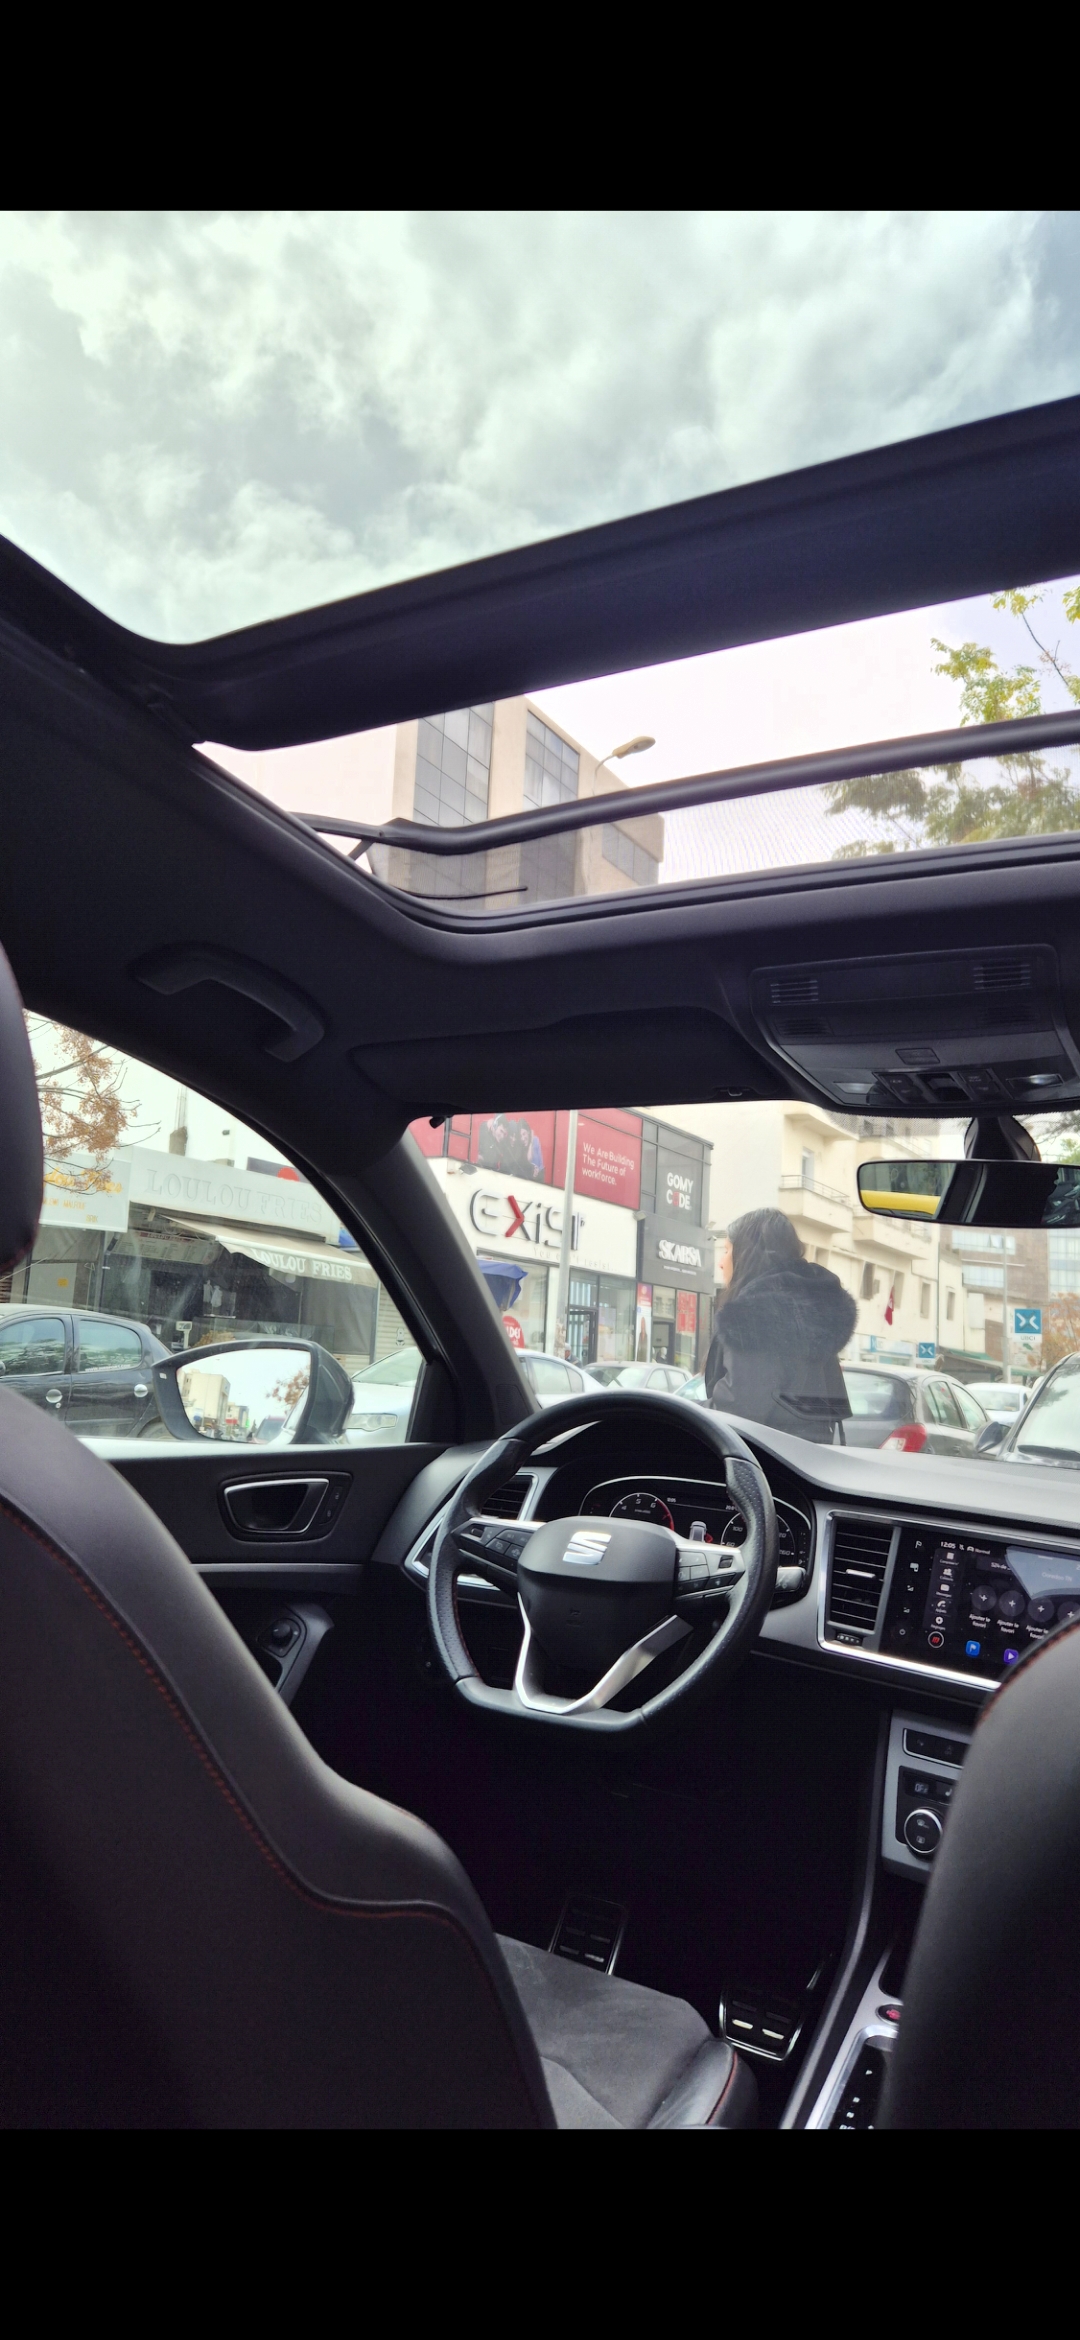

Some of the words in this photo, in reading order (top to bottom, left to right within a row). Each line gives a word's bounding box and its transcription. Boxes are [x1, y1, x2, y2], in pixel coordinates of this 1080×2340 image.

[583, 1141, 595, 1155] We
[597, 1147, 609, 1160] Are
[609, 1151, 635, 1171] Building
[583, 1153, 596, 1167] The
[597, 1158, 619, 1175] Future
[619, 1166, 627, 1177] of
[666, 1171, 694, 1194] GOMY
[145, 1168, 252, 1210] LOULOU
[253, 1191, 323, 1223] FRIES
[251, 1248, 306, 1274] LOULOU
[312, 1260, 353, 1281] FRIES
[1020, 1334, 1037, 1342] UBCI
[940, 1541, 956, 1550] 12:05
